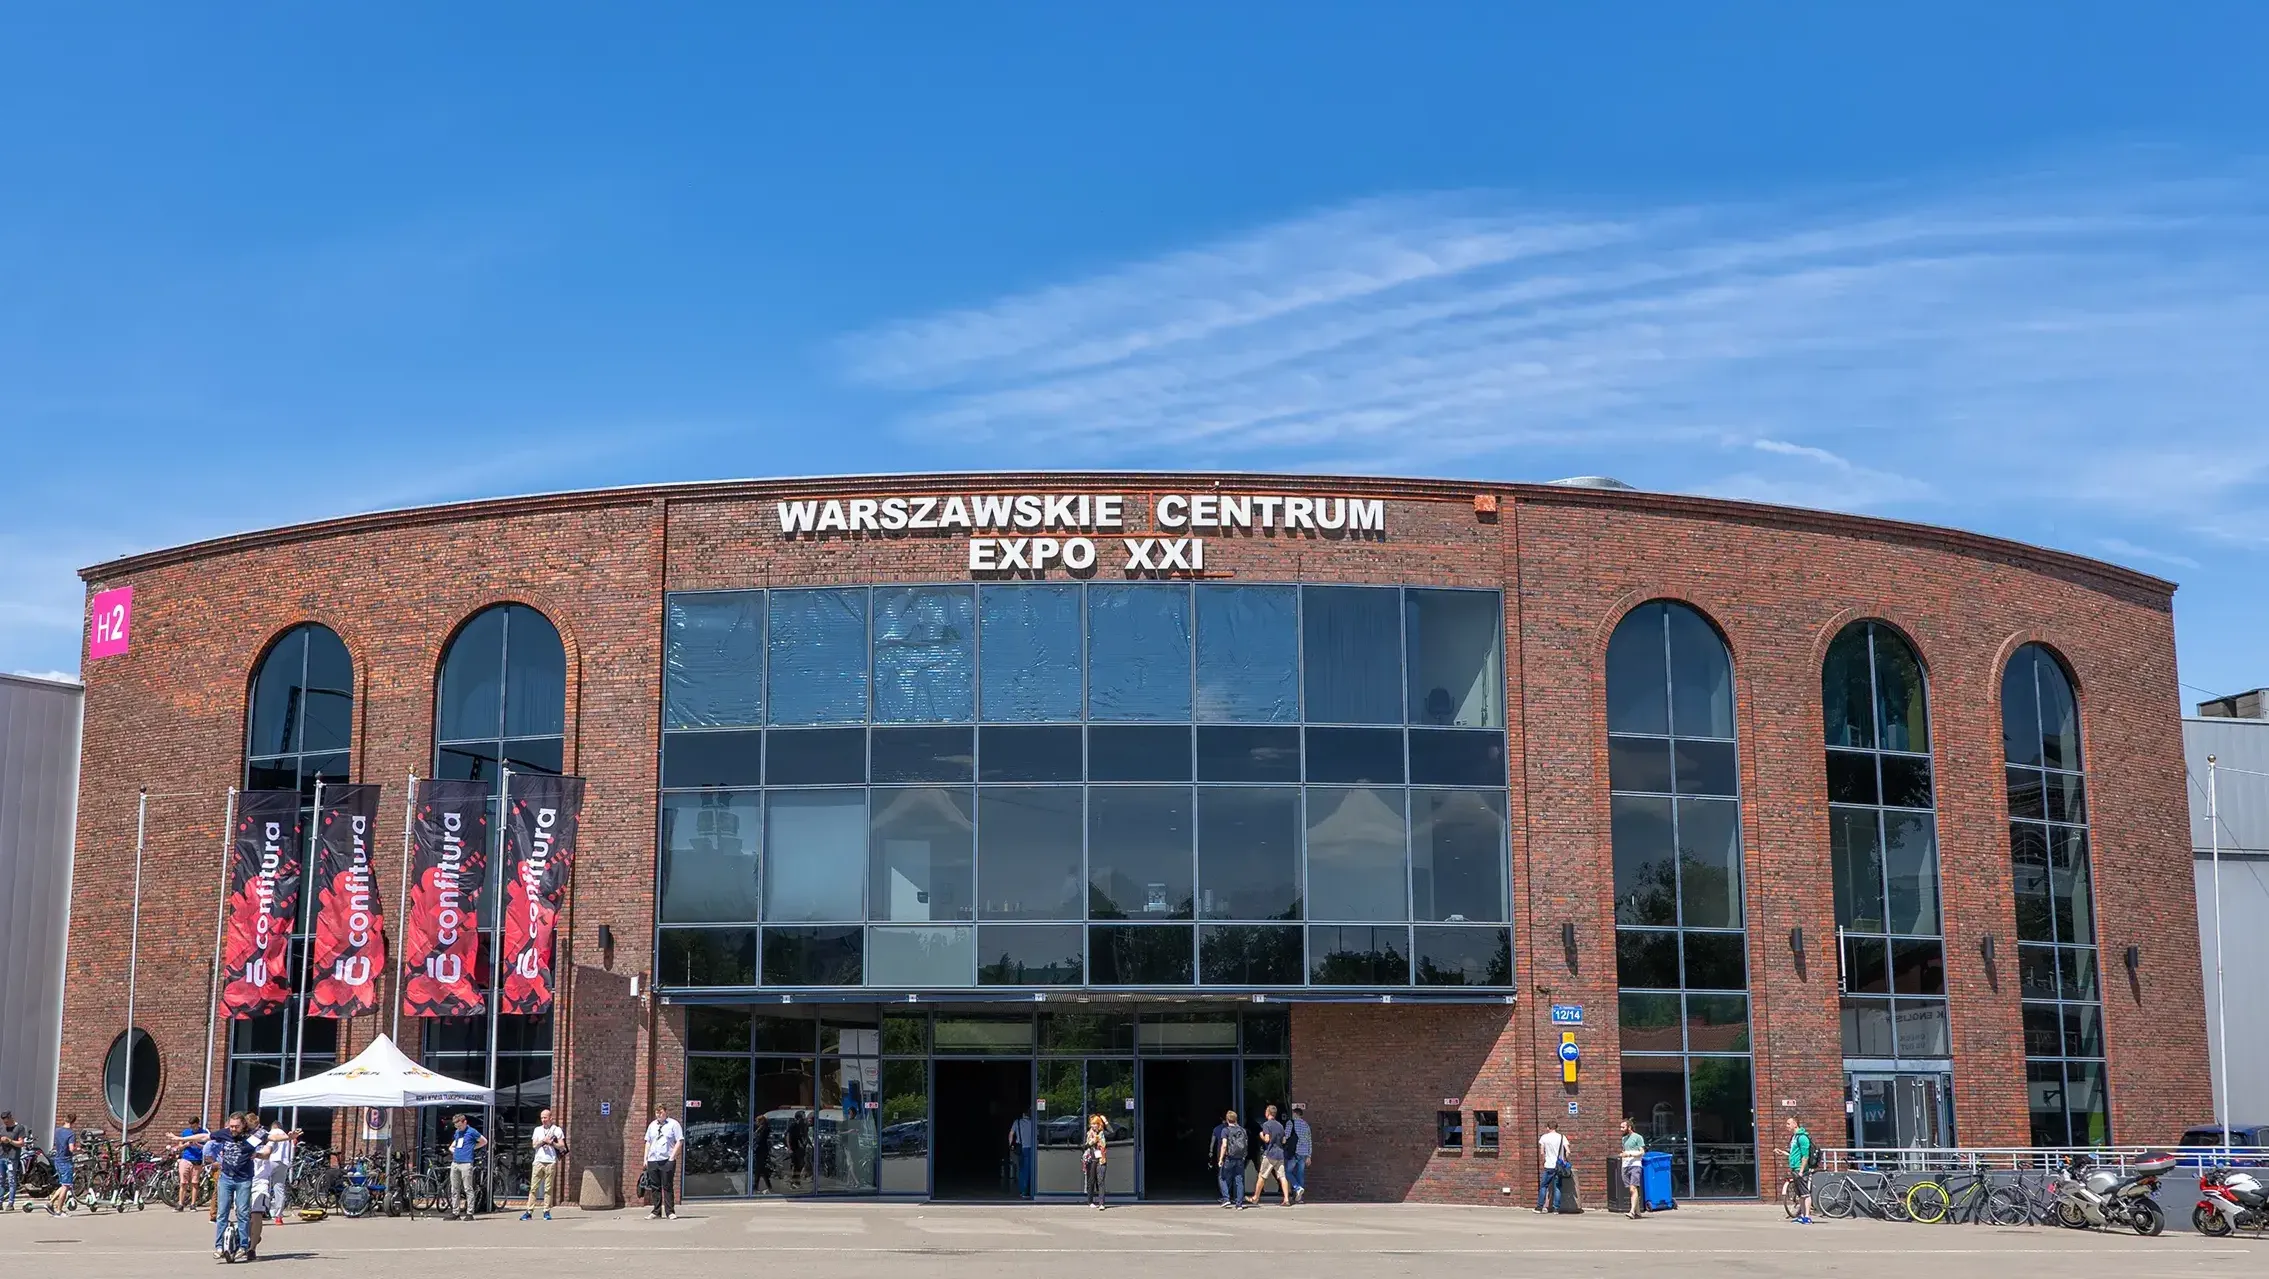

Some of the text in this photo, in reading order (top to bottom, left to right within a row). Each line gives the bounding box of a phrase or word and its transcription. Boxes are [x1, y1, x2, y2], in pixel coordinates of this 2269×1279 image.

[777, 494, 1386, 533] WARSZAWSKIE CENTRUM
[969, 537, 1204, 570] EXPO XXI
[97, 604, 125, 644] H2
[255, 821, 281, 950] confitura
[345, 815, 369, 948] confitura
[433, 812, 462, 946] confitura
[522, 807, 557, 939] confitura
[1556, 1010, 1580, 1020] 12/14
